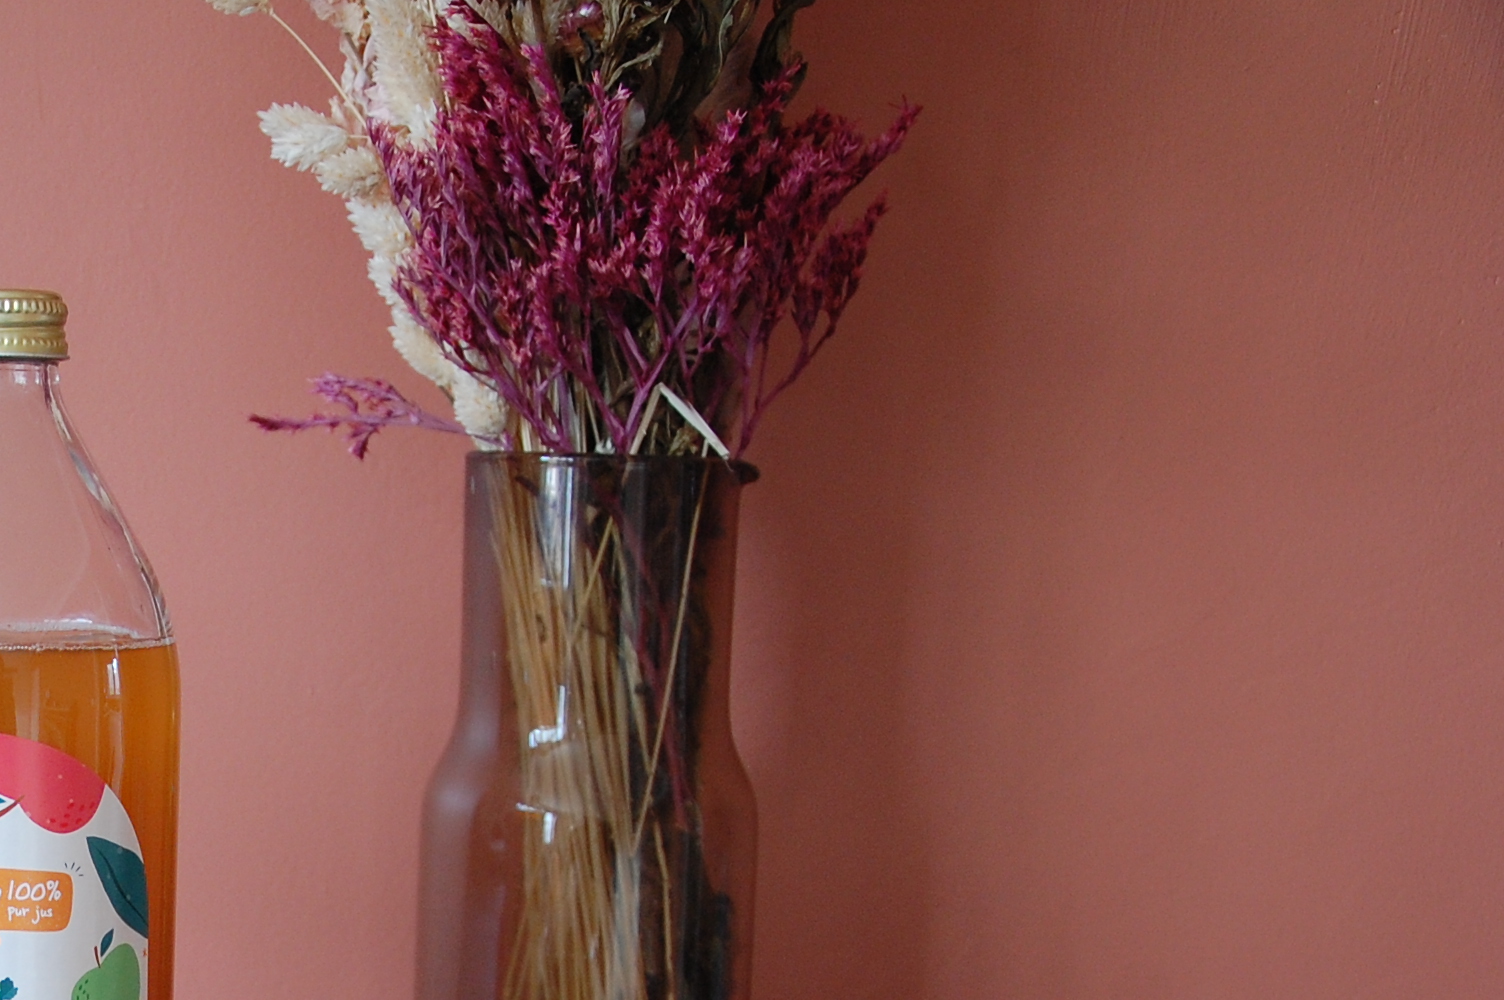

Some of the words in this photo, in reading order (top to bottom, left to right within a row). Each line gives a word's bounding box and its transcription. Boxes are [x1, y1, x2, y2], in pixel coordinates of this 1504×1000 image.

[7, 879, 62, 901] 100%
[7, 905, 30, 921] pur
[31, 905, 53, 924] jus
